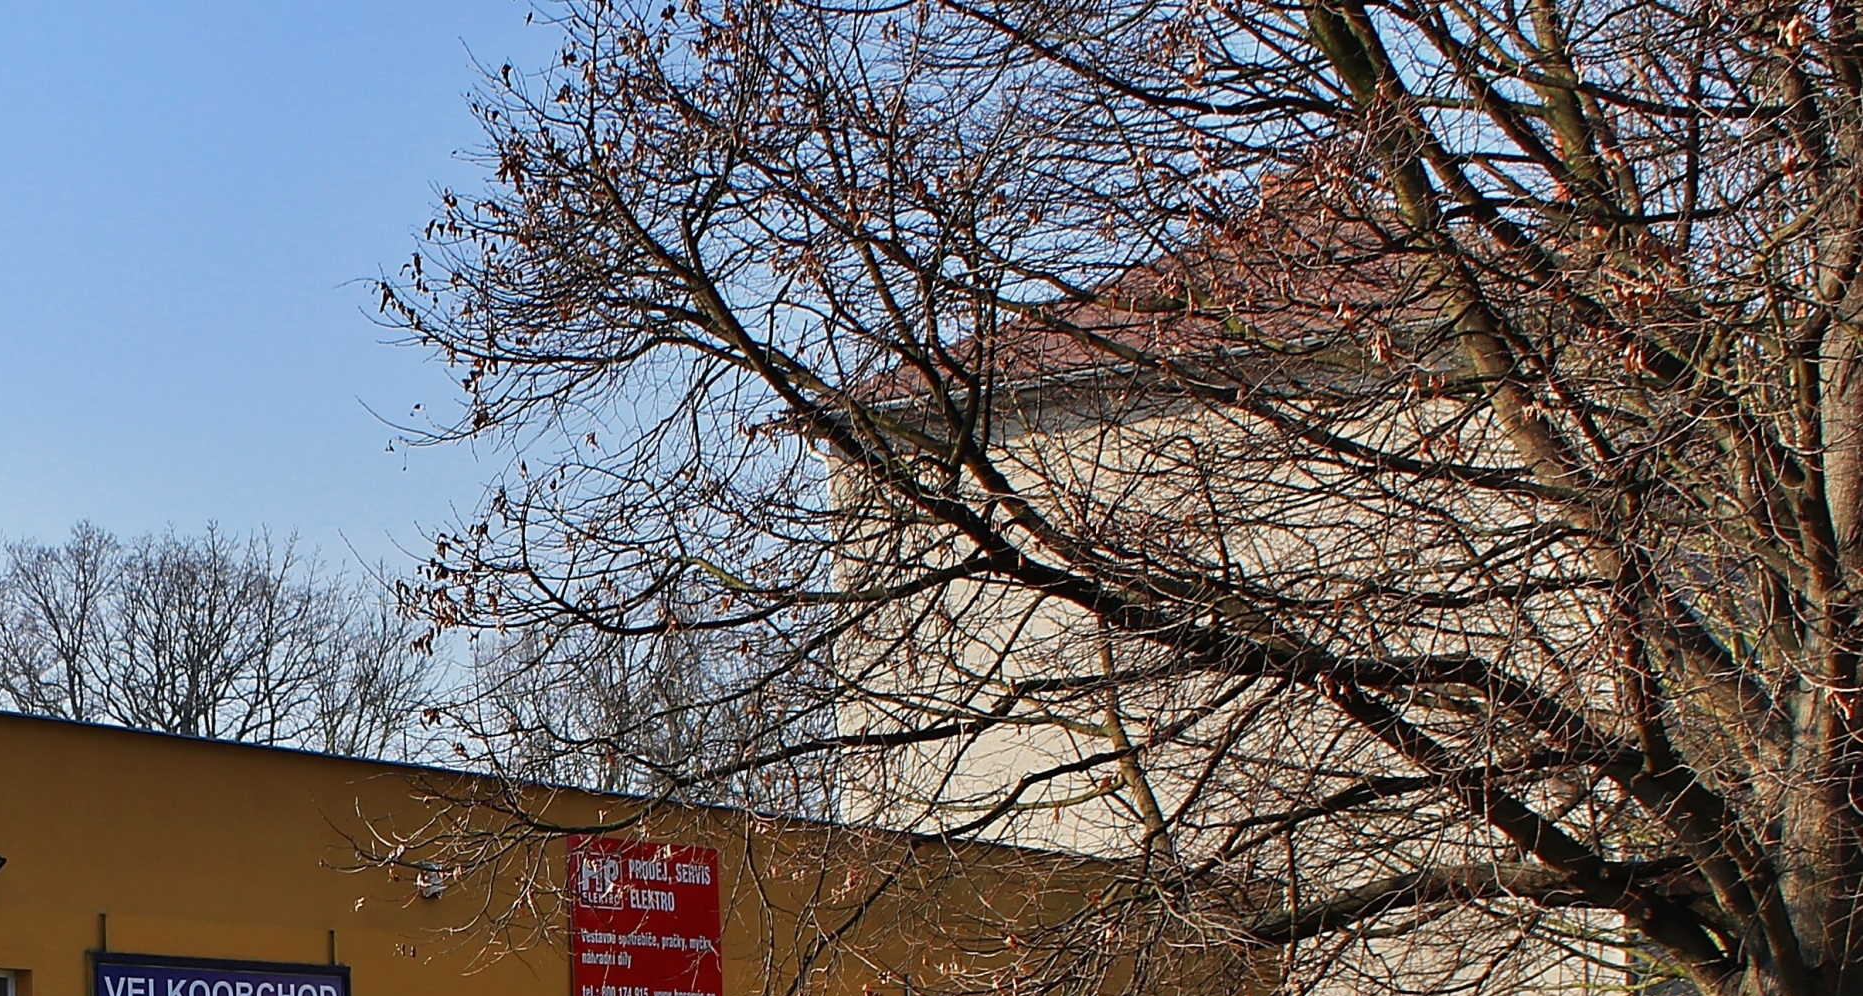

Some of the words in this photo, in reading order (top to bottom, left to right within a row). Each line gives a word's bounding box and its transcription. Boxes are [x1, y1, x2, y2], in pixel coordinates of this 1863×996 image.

[628, 859, 672, 884] PRODEJ,
[675, 863, 711, 885] SERVIS
[630, 888, 675, 912] ELEKTRO
